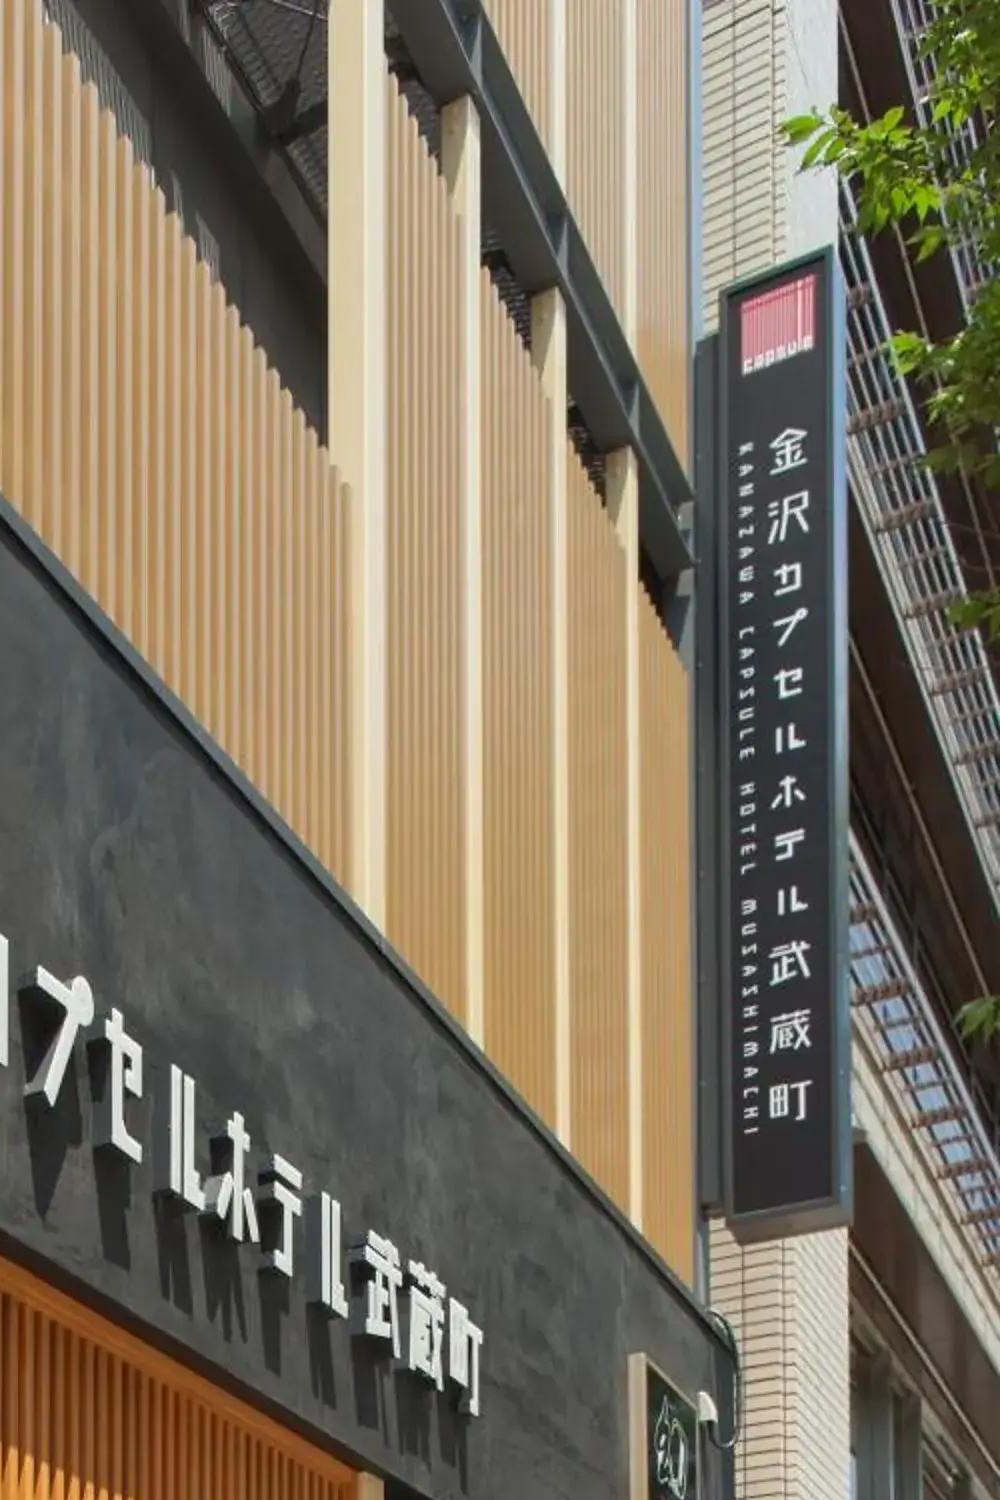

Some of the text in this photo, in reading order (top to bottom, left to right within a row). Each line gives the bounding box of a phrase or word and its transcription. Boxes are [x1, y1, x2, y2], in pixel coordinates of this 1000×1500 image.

[738, 441, 759, 1135] KANAZAWA CAPSULE HOTEL MUSASHIMACHI
[767, 427, 813, 1121] 金沢カプセルホテル武蔵町
